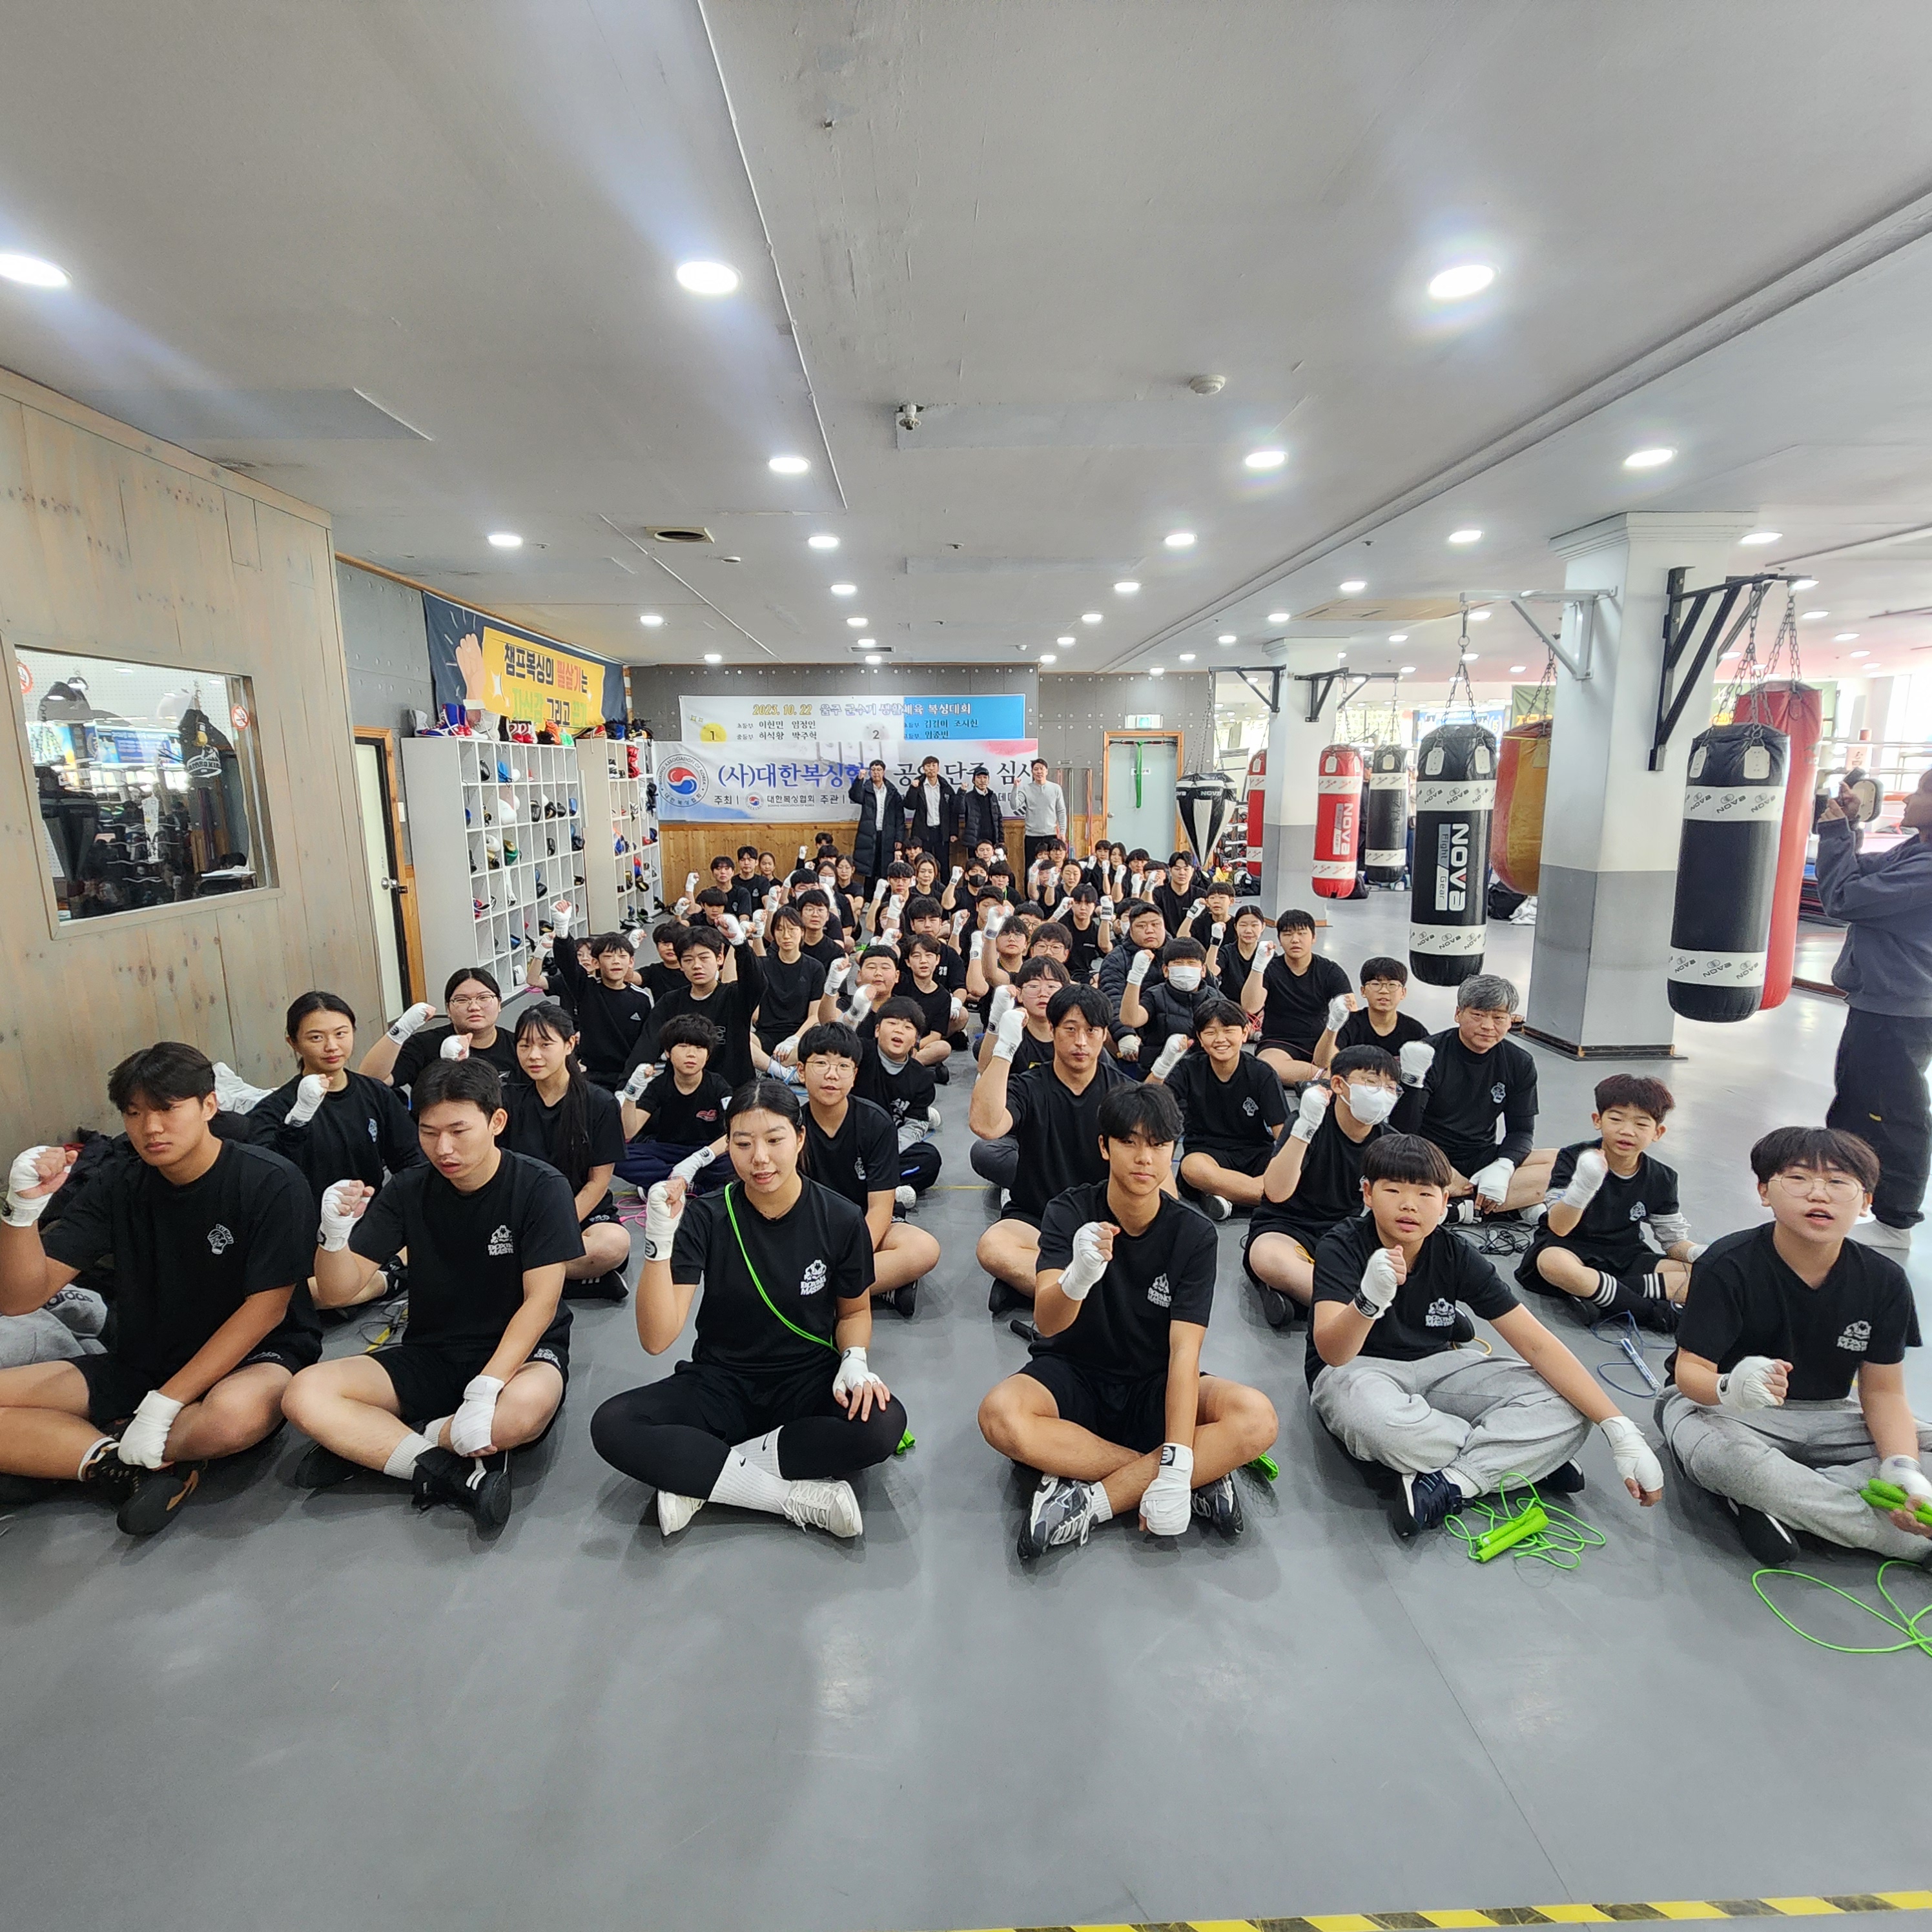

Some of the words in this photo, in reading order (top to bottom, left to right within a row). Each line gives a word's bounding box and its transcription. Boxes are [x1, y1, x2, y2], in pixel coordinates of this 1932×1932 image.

[504, 642, 554, 686] 챔프복싱의
[546, 697, 570, 726] 그리고
[752, 704, 779, 715] 2023.
[783, 704, 796, 715] 10.
[799, 704, 812, 715] 22
[819, 703, 842, 715] 울주
[845, 703, 876, 715] 군수기
[879, 703, 924, 715] 생활체육
[928, 703, 972, 715] 복싱대회
[710, 730, 715, 741] 1
[872, 730, 879, 739] 2
[658, 766, 666, 785] BOXING
[664, 756, 695, 767] ASSOCIATION
[718, 763, 870, 789] (사)대한복싱협
[714, 795, 732, 805] 주최
[767, 795, 815, 803] 대한복싱협회
[820, 795, 839, 805] 주관
[1439, 833, 1449, 859] Fight
[1439, 876, 1447, 899] Gear
